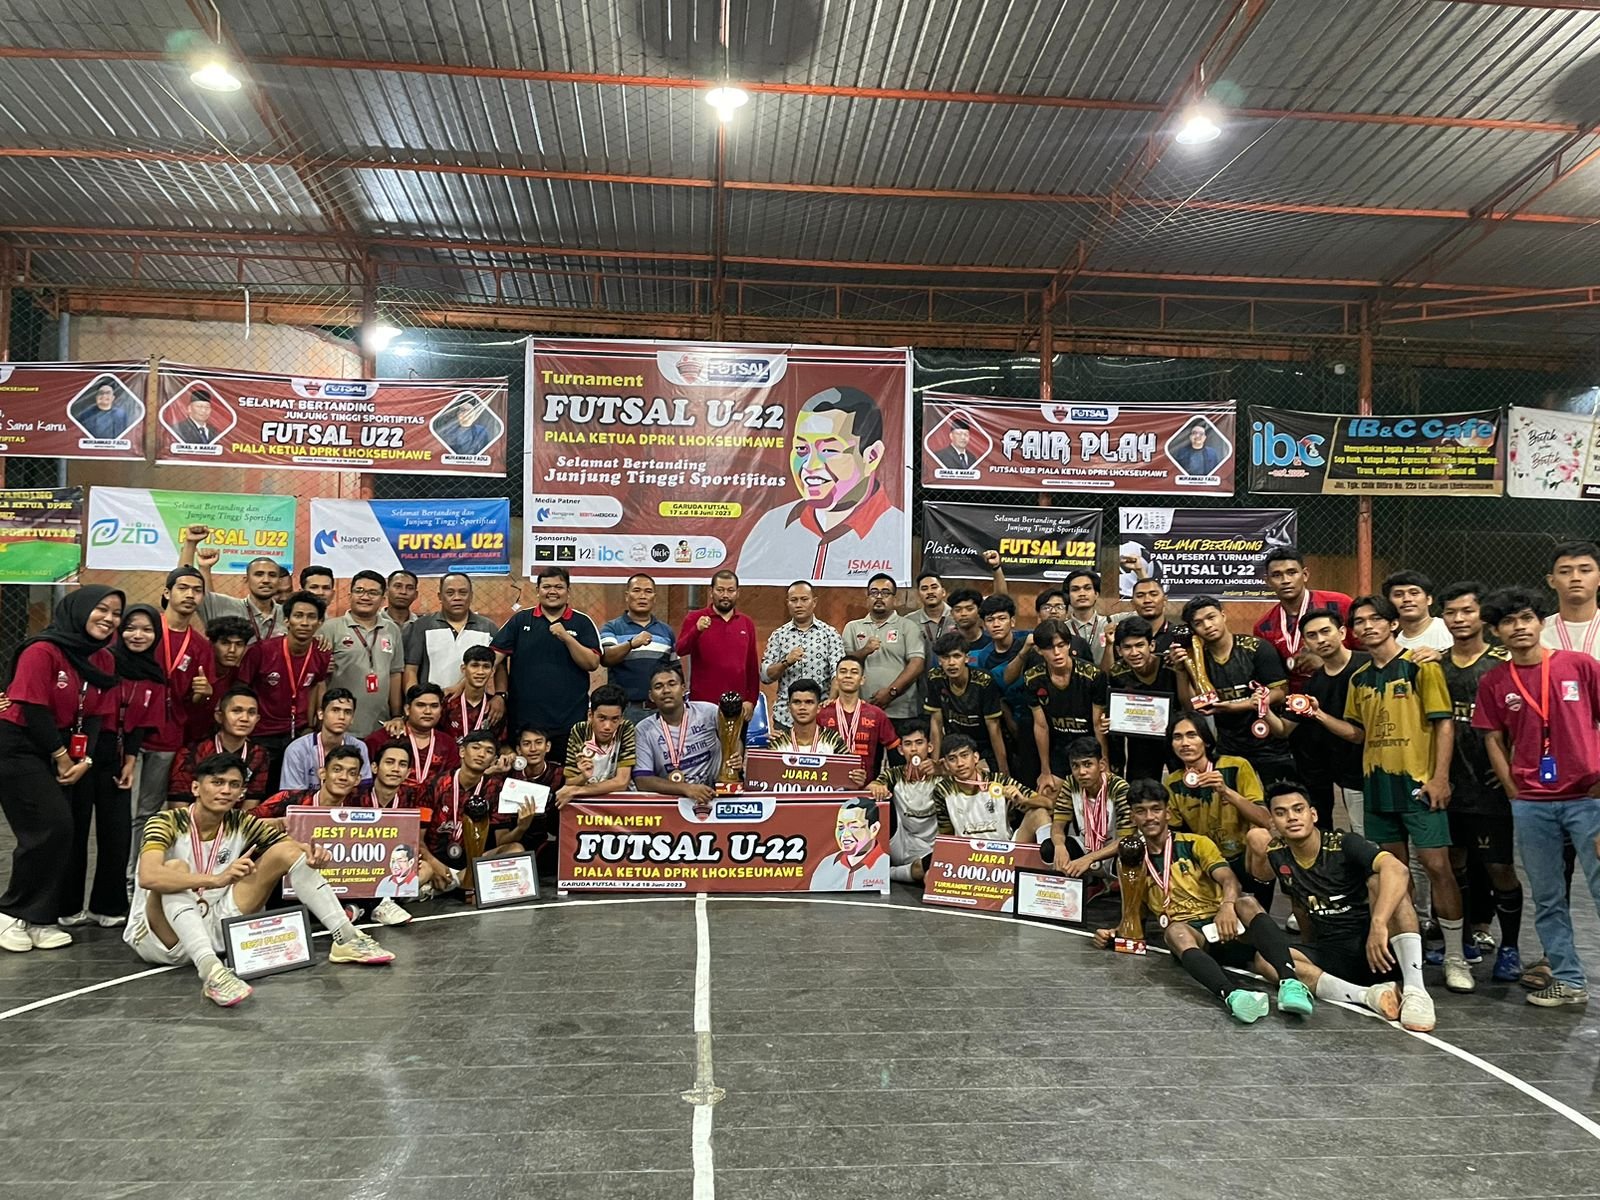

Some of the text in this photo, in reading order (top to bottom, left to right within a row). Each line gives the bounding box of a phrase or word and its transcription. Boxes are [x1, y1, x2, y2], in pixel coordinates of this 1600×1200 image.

[709, 361, 769, 377] FUTSAL
[541, 370, 643, 387] Turnament
[325, 384, 367, 394] FUTSAL
[238, 397, 375, 412] SELAMAT BERTANDING
[284, 412, 424, 424] JUNJUNG TINGGI SPORTIFITAS
[543, 394, 785, 430] FUTSAL U-22
[1072, 408, 1108, 418] FUTSAL
[6, 419, 67, 432] Sama Kamu
[1421, 417, 1493, 438] Cafe
[261, 423, 405, 448] FUTSAL U22
[544, 431, 785, 449] PIALA KETUA DPRK LHOKSEUMAWE
[232, 443, 432, 460] PIALA KETUA DPRK LHOKSEUMAWE
[1001, 428, 1157, 465] FAIR PLAY
[556, 455, 707, 472] Selamat Bertanding
[989, 465, 1168, 478] FUTSAL U22 PIALA KETUA DPRK LHOKSEUMAWE
[544, 469, 786, 490] Junjung Tinggi Sportifitas
[174, 501, 260, 513] Selamat Bertanding dan
[391, 508, 475, 518] Selamat Bertanding dan
[185, 511, 282, 523] Junjung Tinggi Sportifitas
[404, 517, 497, 527] Junjung Tinggi Sportifitas
[994, 515, 1071, 525] Selamat Bertanding dan
[1005, 524, 1090, 534] Junjung Tinggi Sportifitas
[178, 527, 289, 547] FTSAL U22
[398, 532, 504, 550] FUTSAL U22
[923, 540, 978, 556] Platinum
[999, 538, 1096, 558] FUTSAL U22
[1154, 538, 1263, 551] SELAMAT BERTANDING
[598, 545, 625, 561] ibc
[1150, 553, 1174, 561] PARA
[1177, 553, 1216, 561] PESERTA
[847, 559, 892, 570] ISMAIL
[1162, 564, 1255, 576] FUTSAL U-22
[1052, 716, 1086, 729] MRF
[799, 757, 820, 765] FUTSAL
[782, 769, 829, 781] JUARA 2
[716, 803, 763, 814] FUTSAL
[350, 812, 375, 820] FUTSAL
[576, 815, 663, 827] TURNAMENT
[313, 827, 399, 839] BEST PLAYER
[576, 833, 805, 863] FUTSAL U-22
[967, 853, 1014, 866] JUARA 1
[342, 868, 369, 876] FUTSAL
[574, 866, 804, 878] PIALA KETUA DPRK LHOKSEUMAWE
[974, 885, 999, 893] FUTSAL
